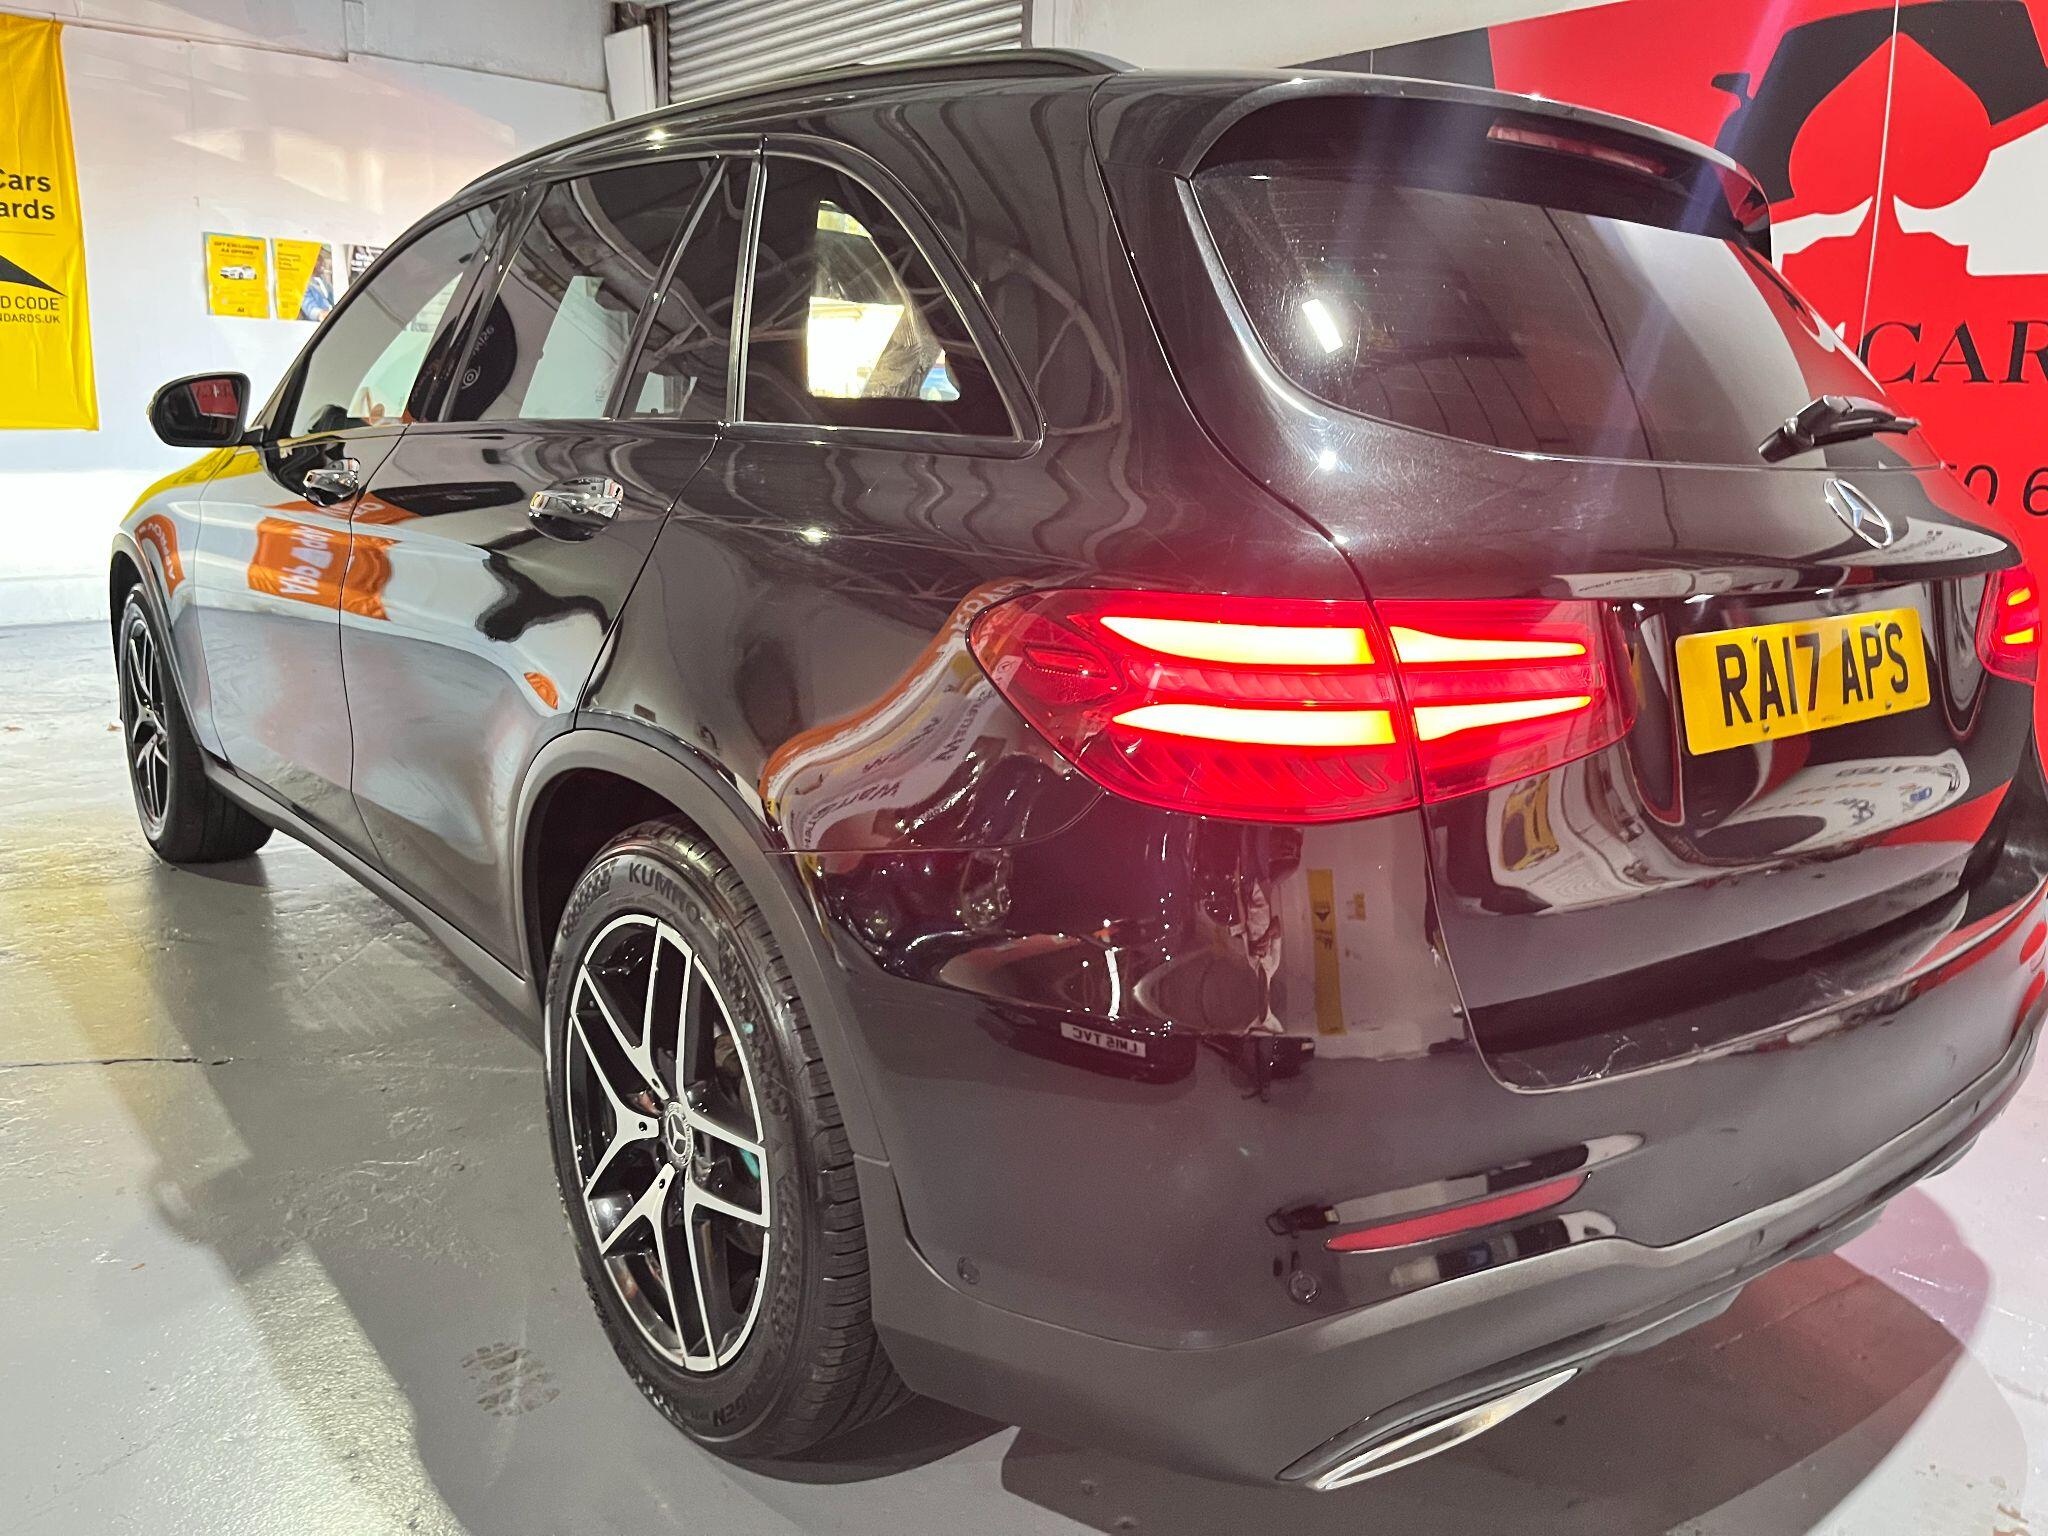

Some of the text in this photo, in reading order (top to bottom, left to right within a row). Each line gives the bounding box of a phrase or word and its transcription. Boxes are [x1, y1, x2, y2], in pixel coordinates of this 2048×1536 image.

[15, 296, 60, 310] CODE
[1716, 622, 1909, 727] RA17 APS
